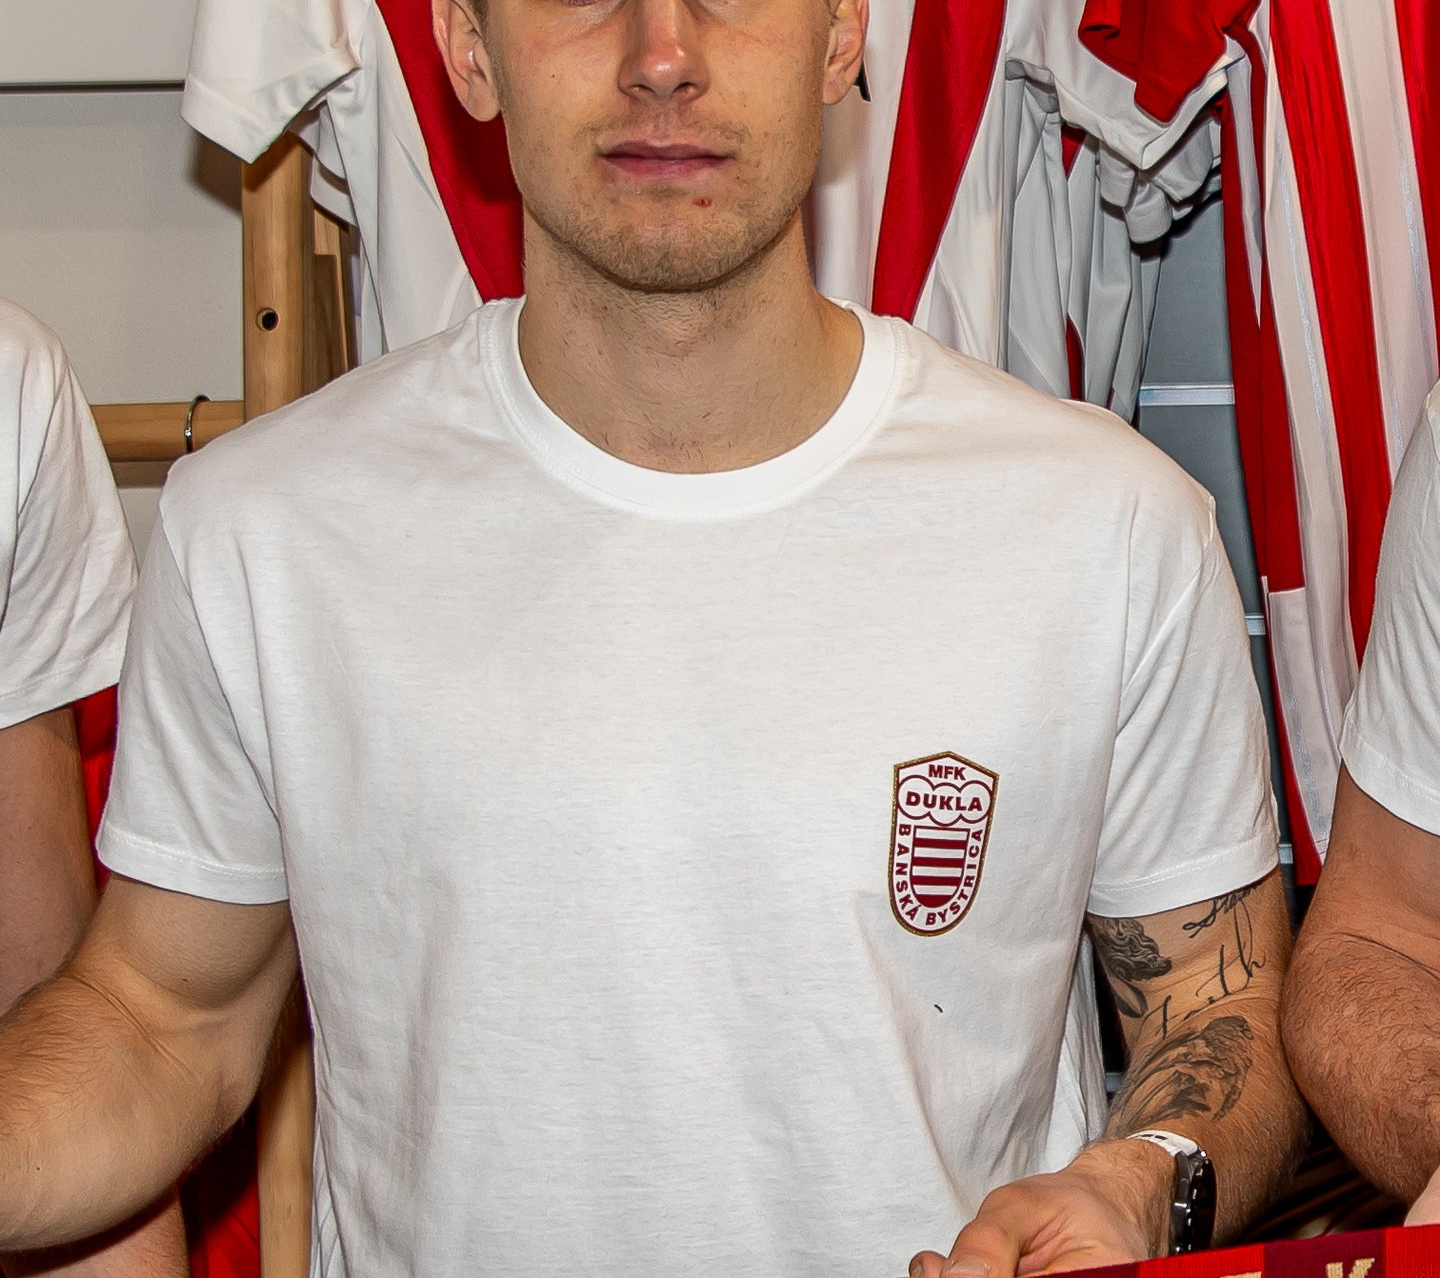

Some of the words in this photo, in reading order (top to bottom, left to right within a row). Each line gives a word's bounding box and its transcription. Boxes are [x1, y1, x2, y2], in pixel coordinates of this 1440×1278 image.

[928, 764, 966, 781] MFK
[905, 791, 983, 812] DUKLA
[895, 823, 922, 921] BANSKÁ
[925, 828, 984, 926] BYSTRICA
